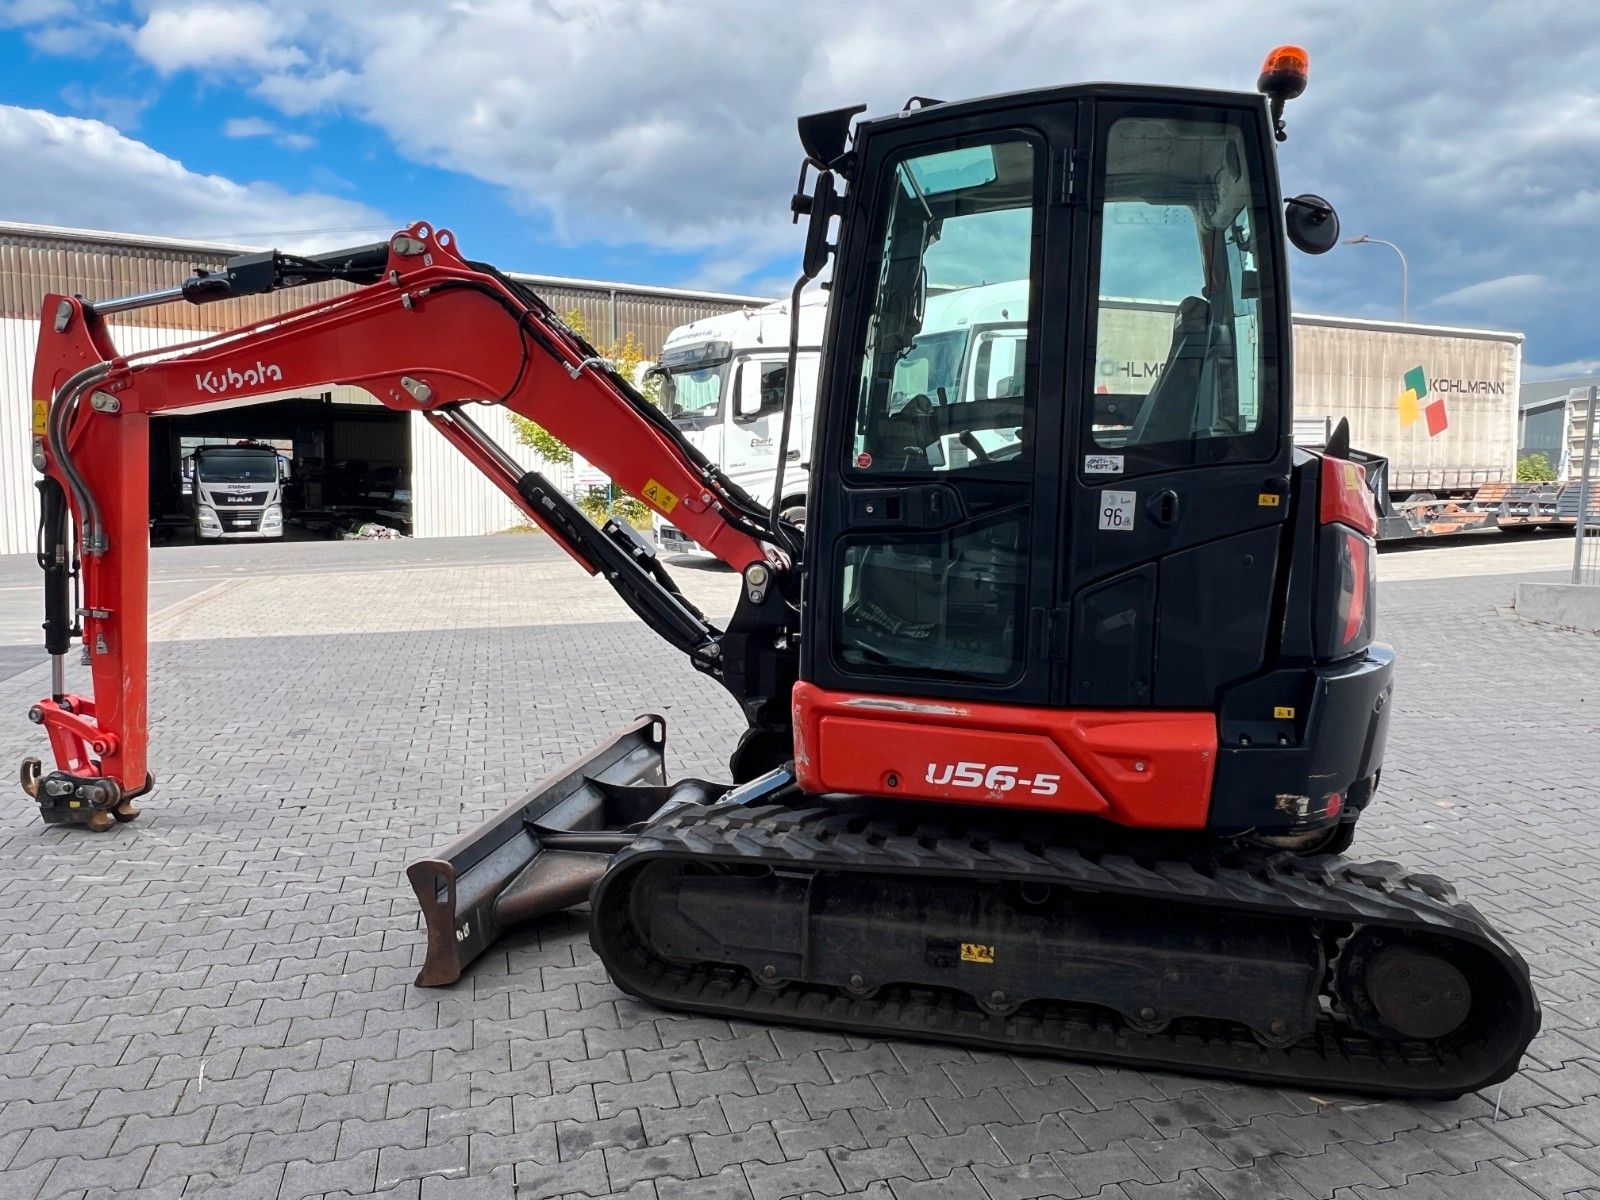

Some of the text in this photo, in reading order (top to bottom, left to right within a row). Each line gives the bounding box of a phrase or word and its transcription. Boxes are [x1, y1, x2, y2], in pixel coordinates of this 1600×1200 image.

[195, 361, 283, 394] Kubota
[1429, 378, 1505, 395] KOHLMANN
[1103, 508, 1123, 526] 96
[925, 761, 1061, 795] U56-5
